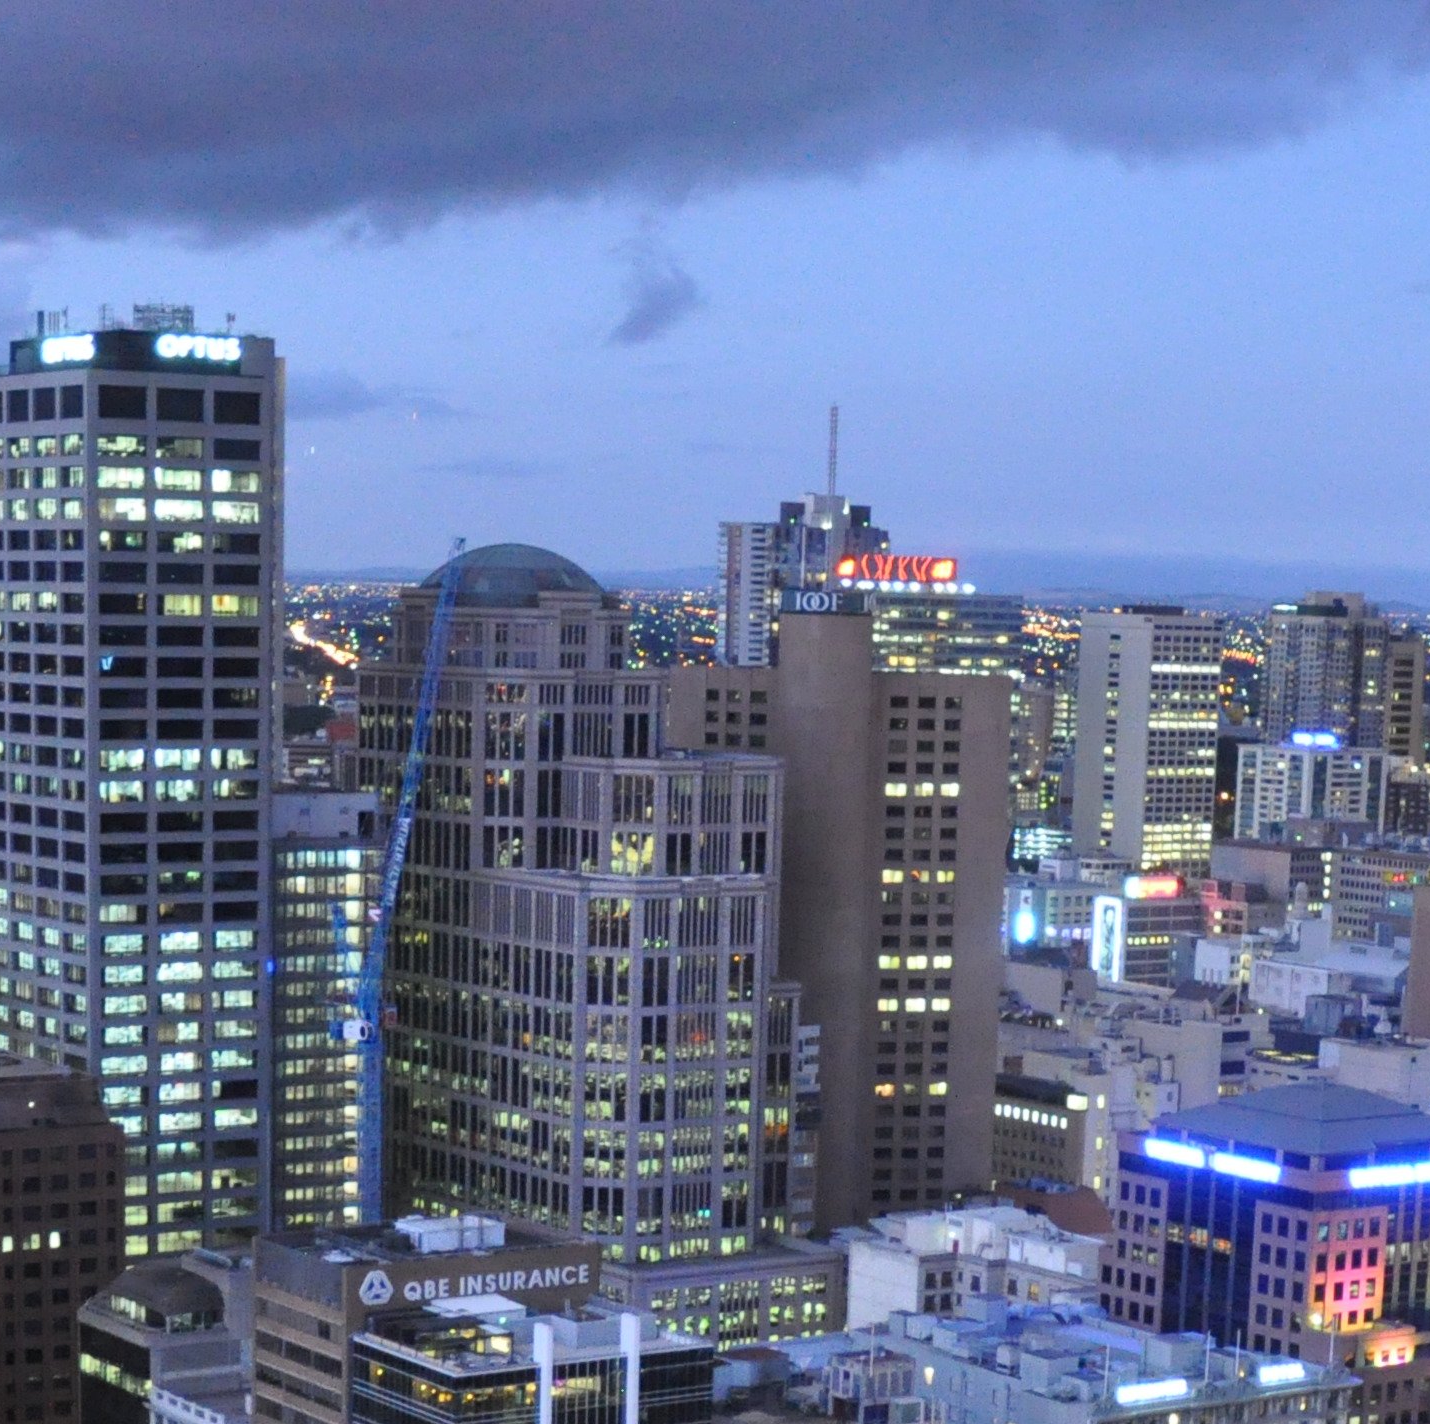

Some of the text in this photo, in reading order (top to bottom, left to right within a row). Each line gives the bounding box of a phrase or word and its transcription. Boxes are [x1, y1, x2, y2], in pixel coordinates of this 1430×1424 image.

[156, 333, 241, 361] OPTUS
[796, 591, 843, 612] IOOF
[403, 1264, 590, 1302] QBE INSURANCE
